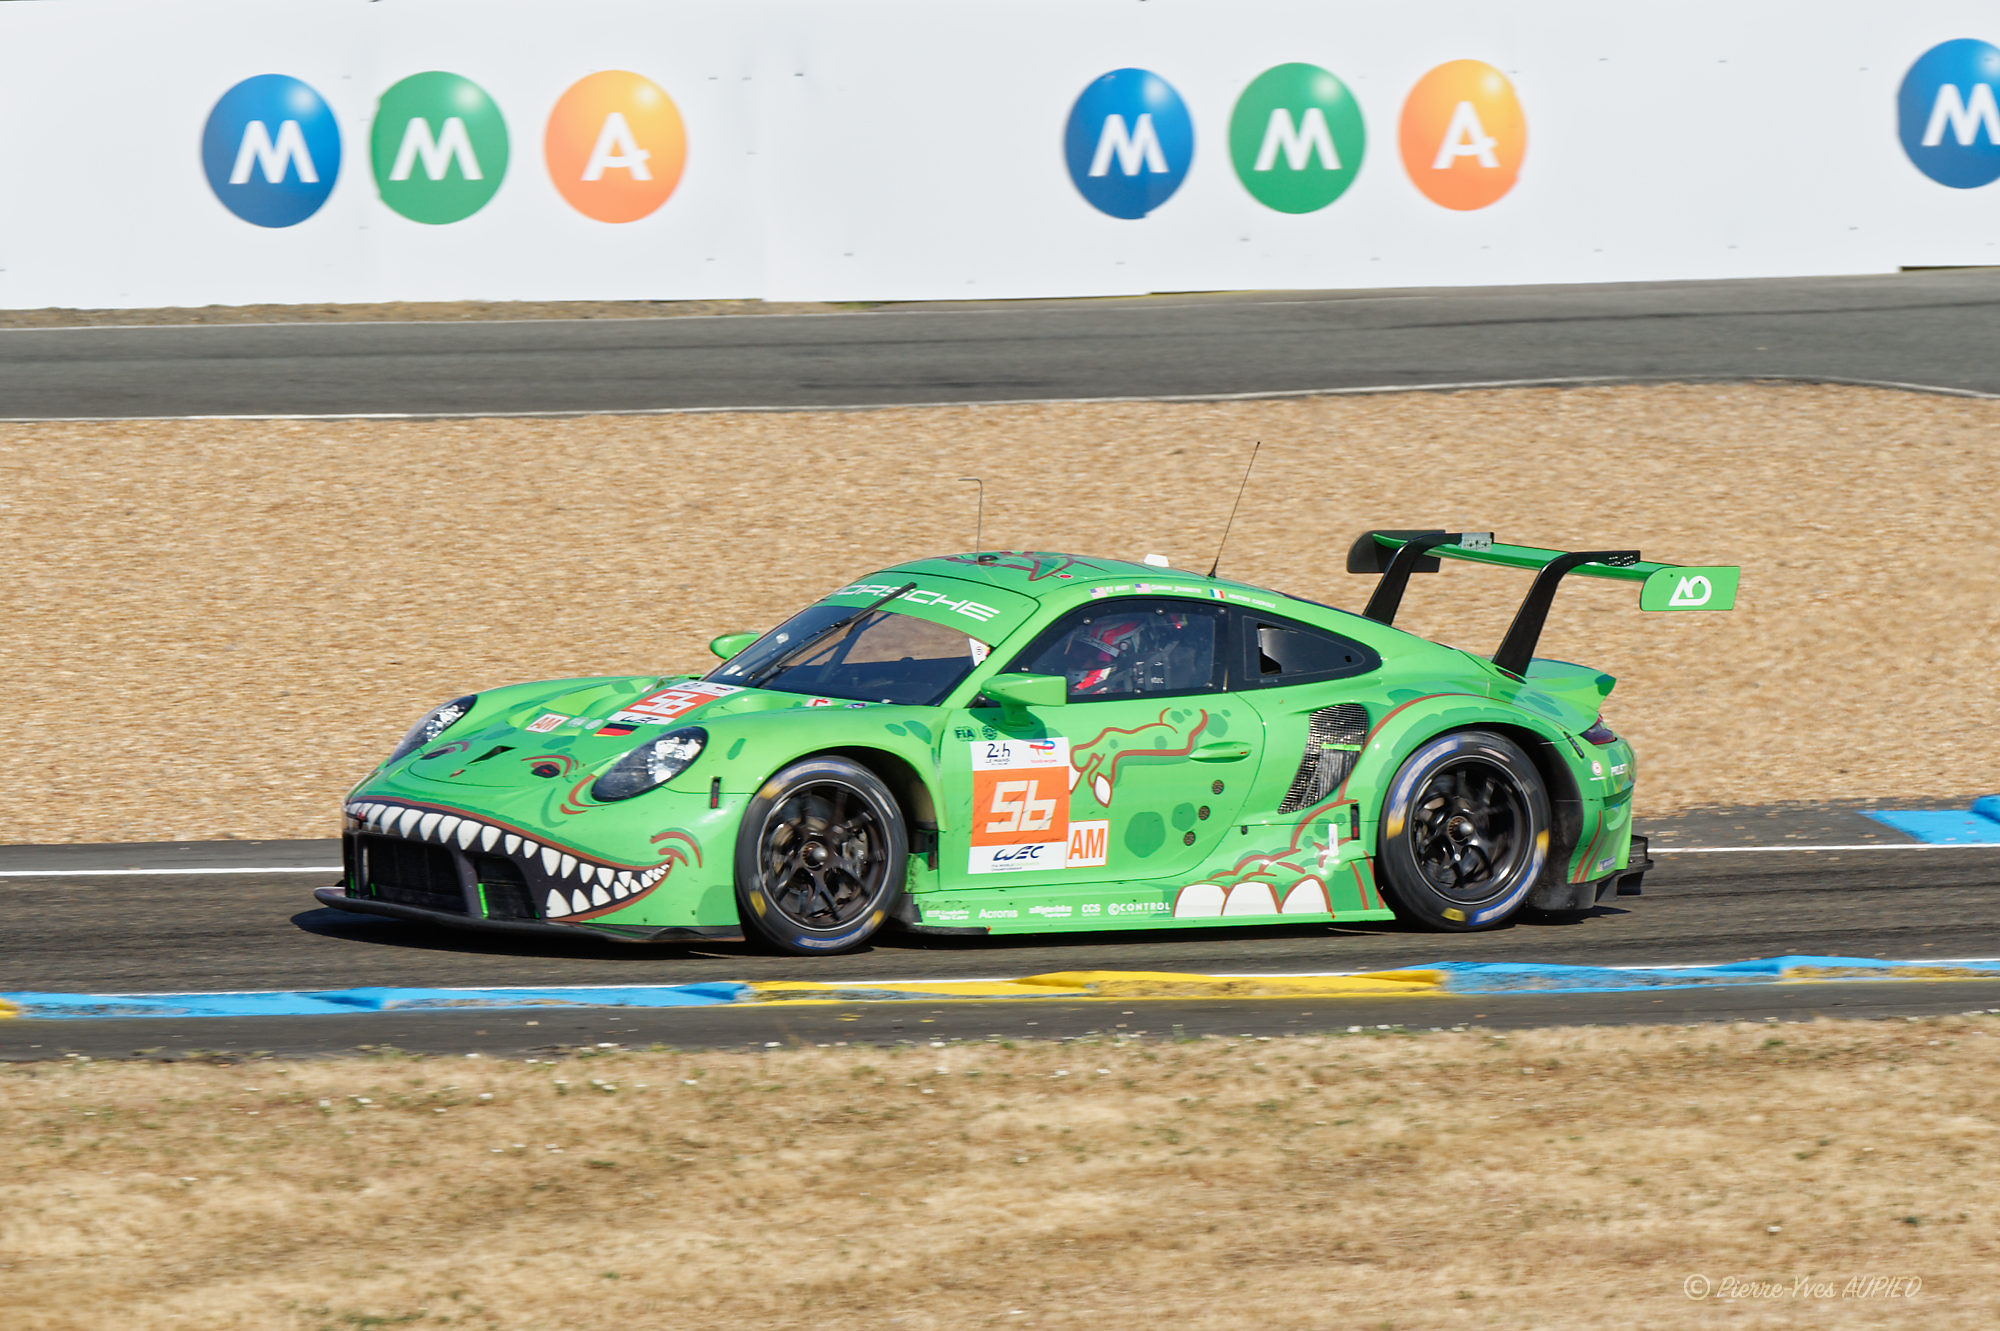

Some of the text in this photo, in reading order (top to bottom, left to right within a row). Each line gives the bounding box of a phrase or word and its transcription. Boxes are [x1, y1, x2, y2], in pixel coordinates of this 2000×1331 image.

[833, 585, 1000, 622] ORSCHE
[985, 780, 1057, 833] 56
[992, 846, 1045, 861] WEC
[1068, 828, 1105, 860] AM
